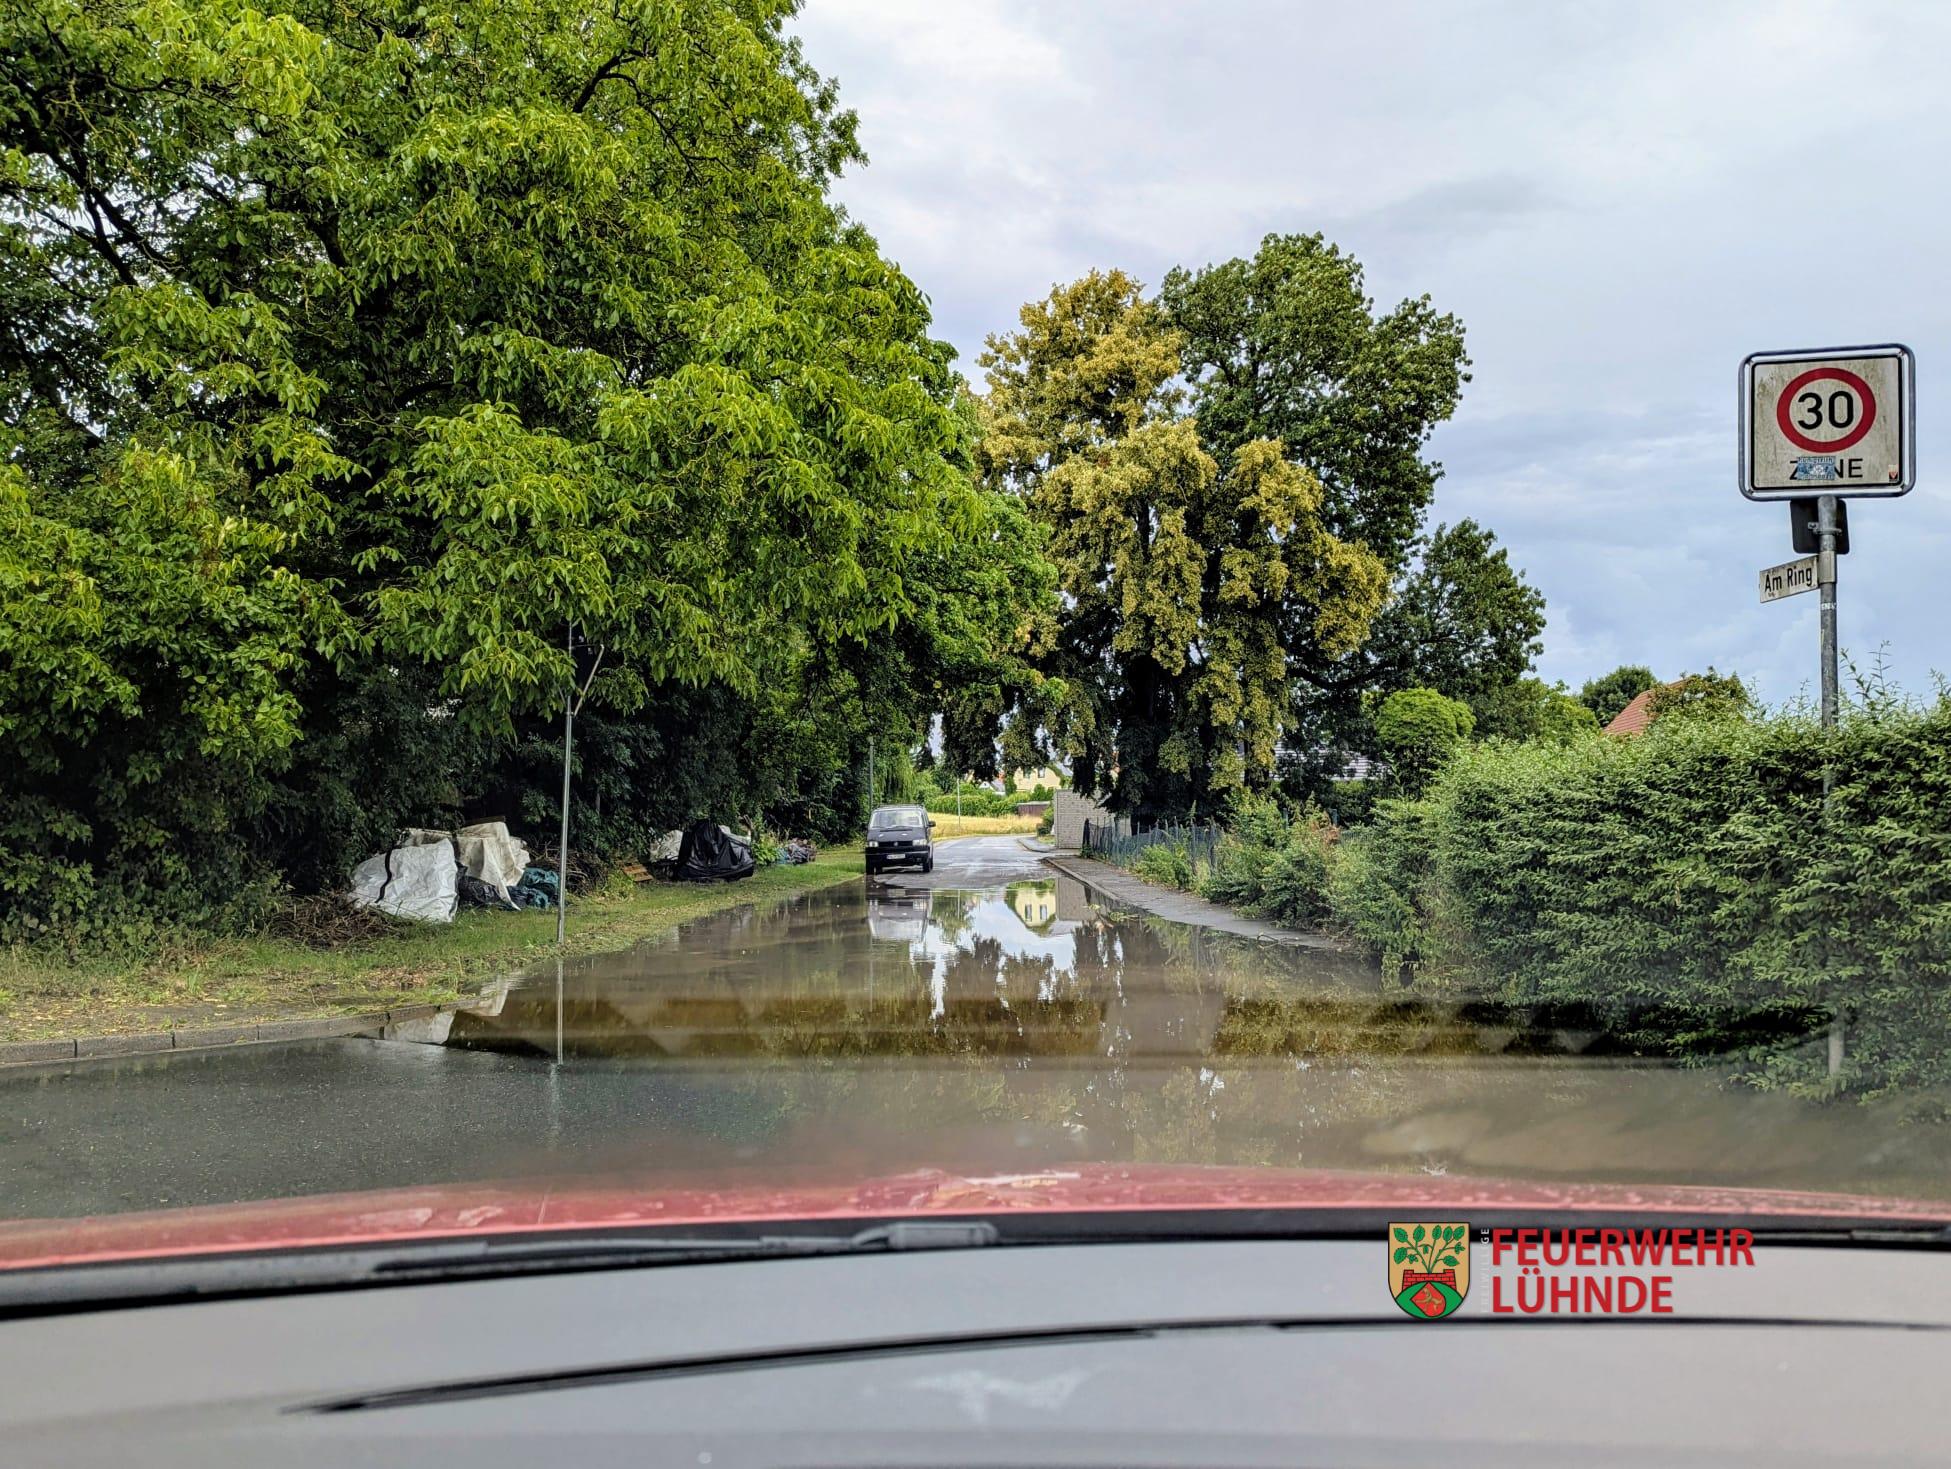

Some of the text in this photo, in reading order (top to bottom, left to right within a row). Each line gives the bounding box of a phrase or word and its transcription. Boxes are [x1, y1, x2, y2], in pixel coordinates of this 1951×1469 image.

[1797, 391, 1854, 430] 30
[1789, 458, 1864, 480] ZNE
[1764, 565, 1813, 593] Am Ring
